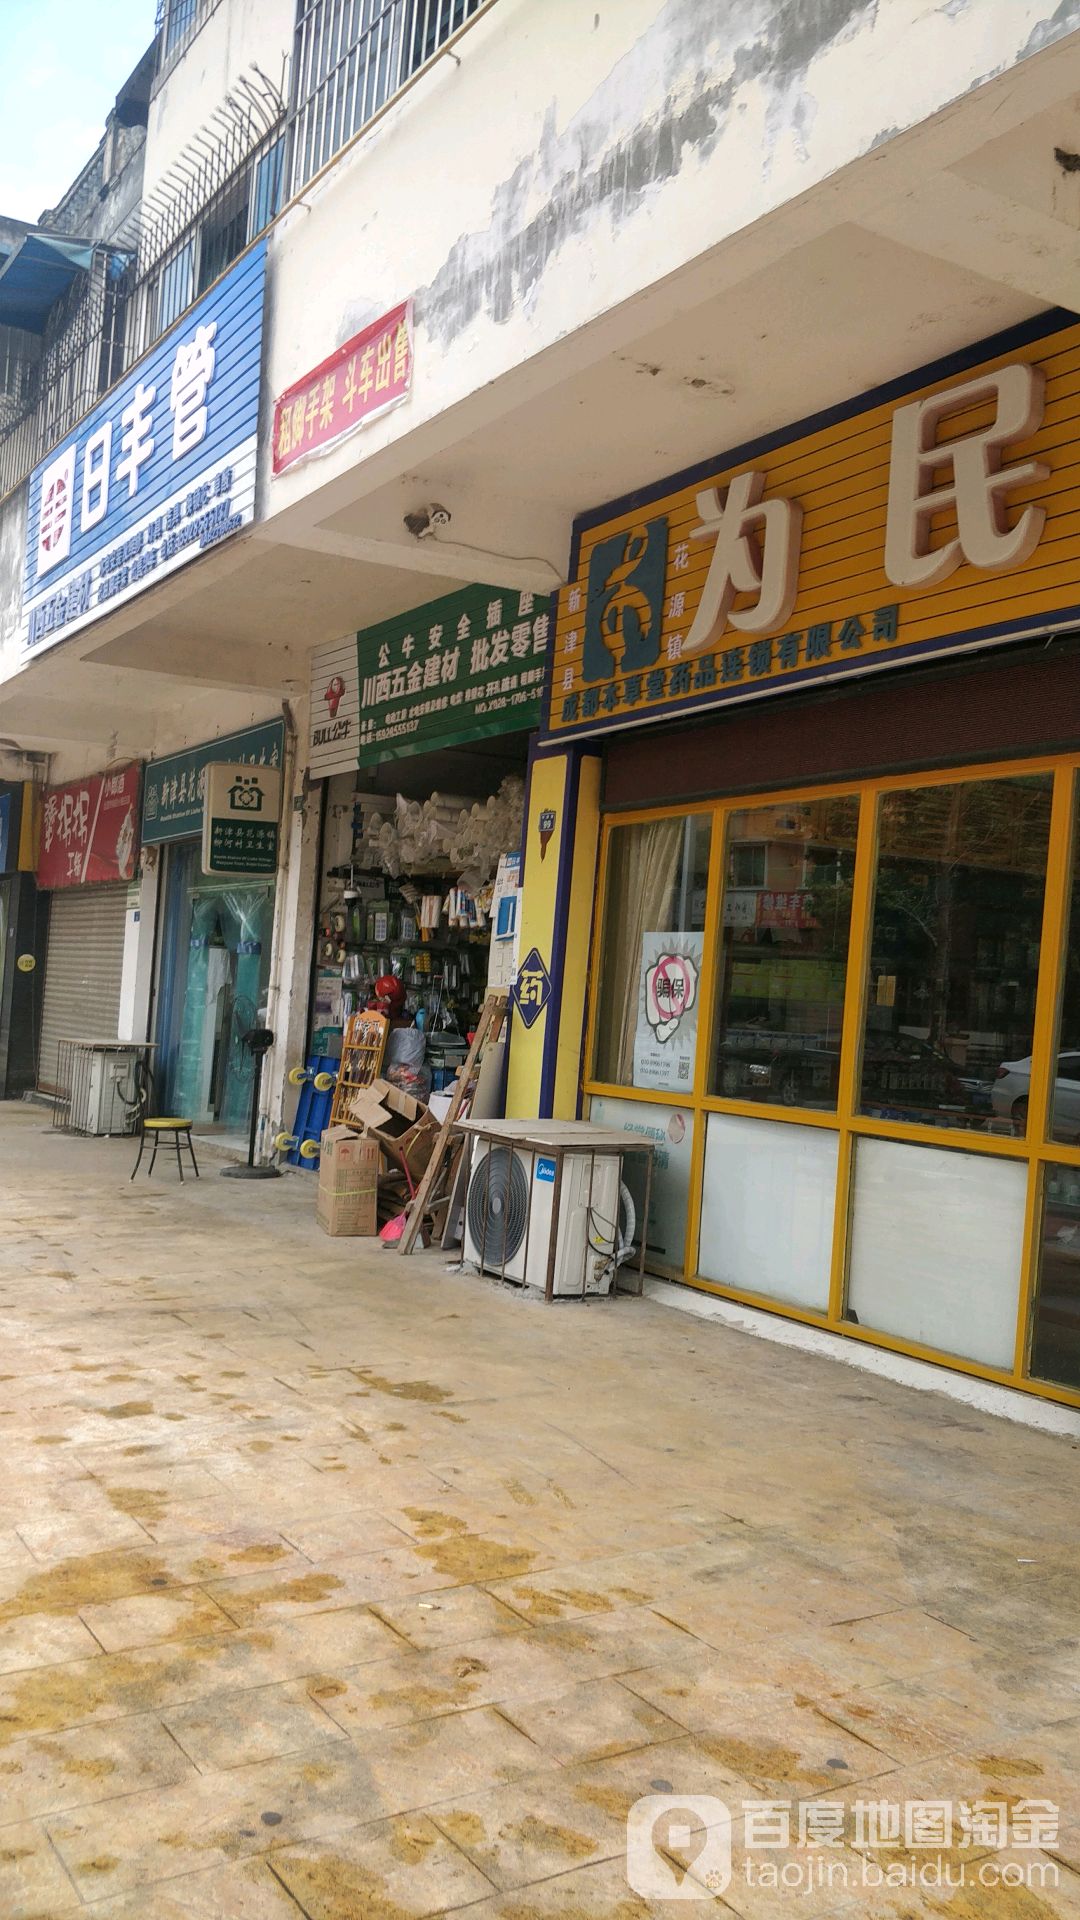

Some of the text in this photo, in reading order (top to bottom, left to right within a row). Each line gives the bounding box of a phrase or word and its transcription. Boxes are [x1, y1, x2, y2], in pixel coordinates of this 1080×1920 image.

[343, 319, 410, 413] 斗车出售
[80, 322, 218, 532] 日丰管
[681, 362, 1050, 653] 为民
[27, 569, 92, 645] 川西五金建材
[378, 591, 534, 668] 公牛安全插座
[563, 588, 581, 690] 新津县
[667, 543, 690, 660] 花源镇
[361, 646, 460, 709] 川西五金建材
[469, 613, 549, 675] 批发零售
[561, 604, 900, 722] 成都本草堂药品连锁有限公司
[519, 969, 544, 1006] 药
[657, 978, 685, 999] 骗保
